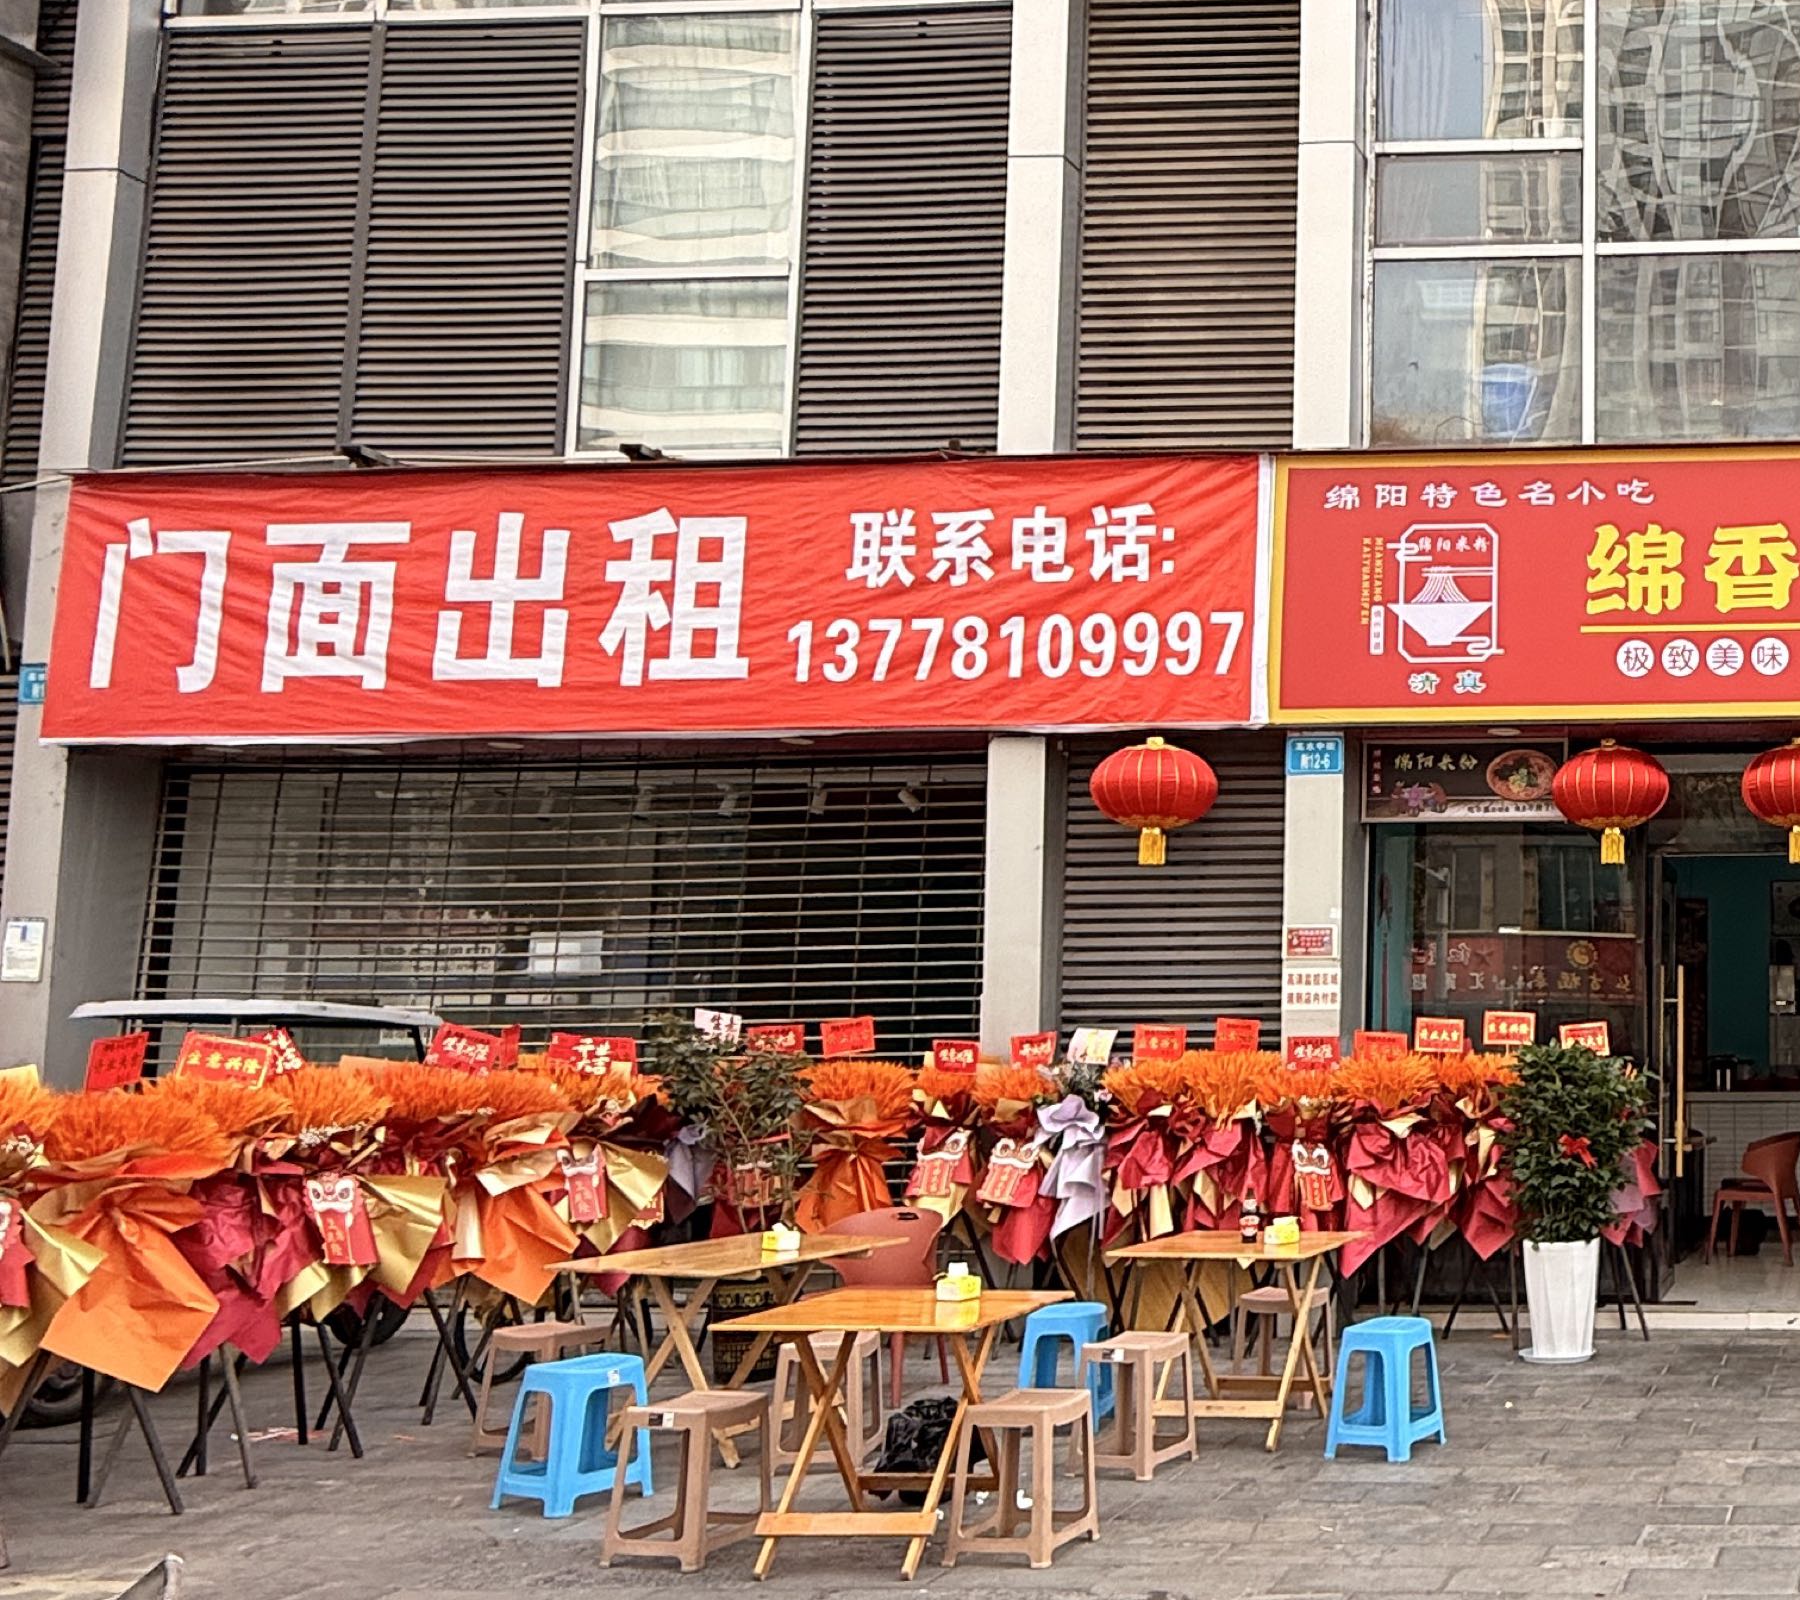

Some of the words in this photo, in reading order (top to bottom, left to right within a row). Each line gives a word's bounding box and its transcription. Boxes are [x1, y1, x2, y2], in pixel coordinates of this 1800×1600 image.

[1323, 477, 1657, 511] 绵阳特色名小吃
[845, 502, 1177, 588] 联系电话:
[88, 505, 750, 694] 门面出租
[786, 610, 1246, 685] 13778109997
[1619, 639, 1787, 675] 极致美味
[188, 1049, 263, 1074] 生意兴隆
